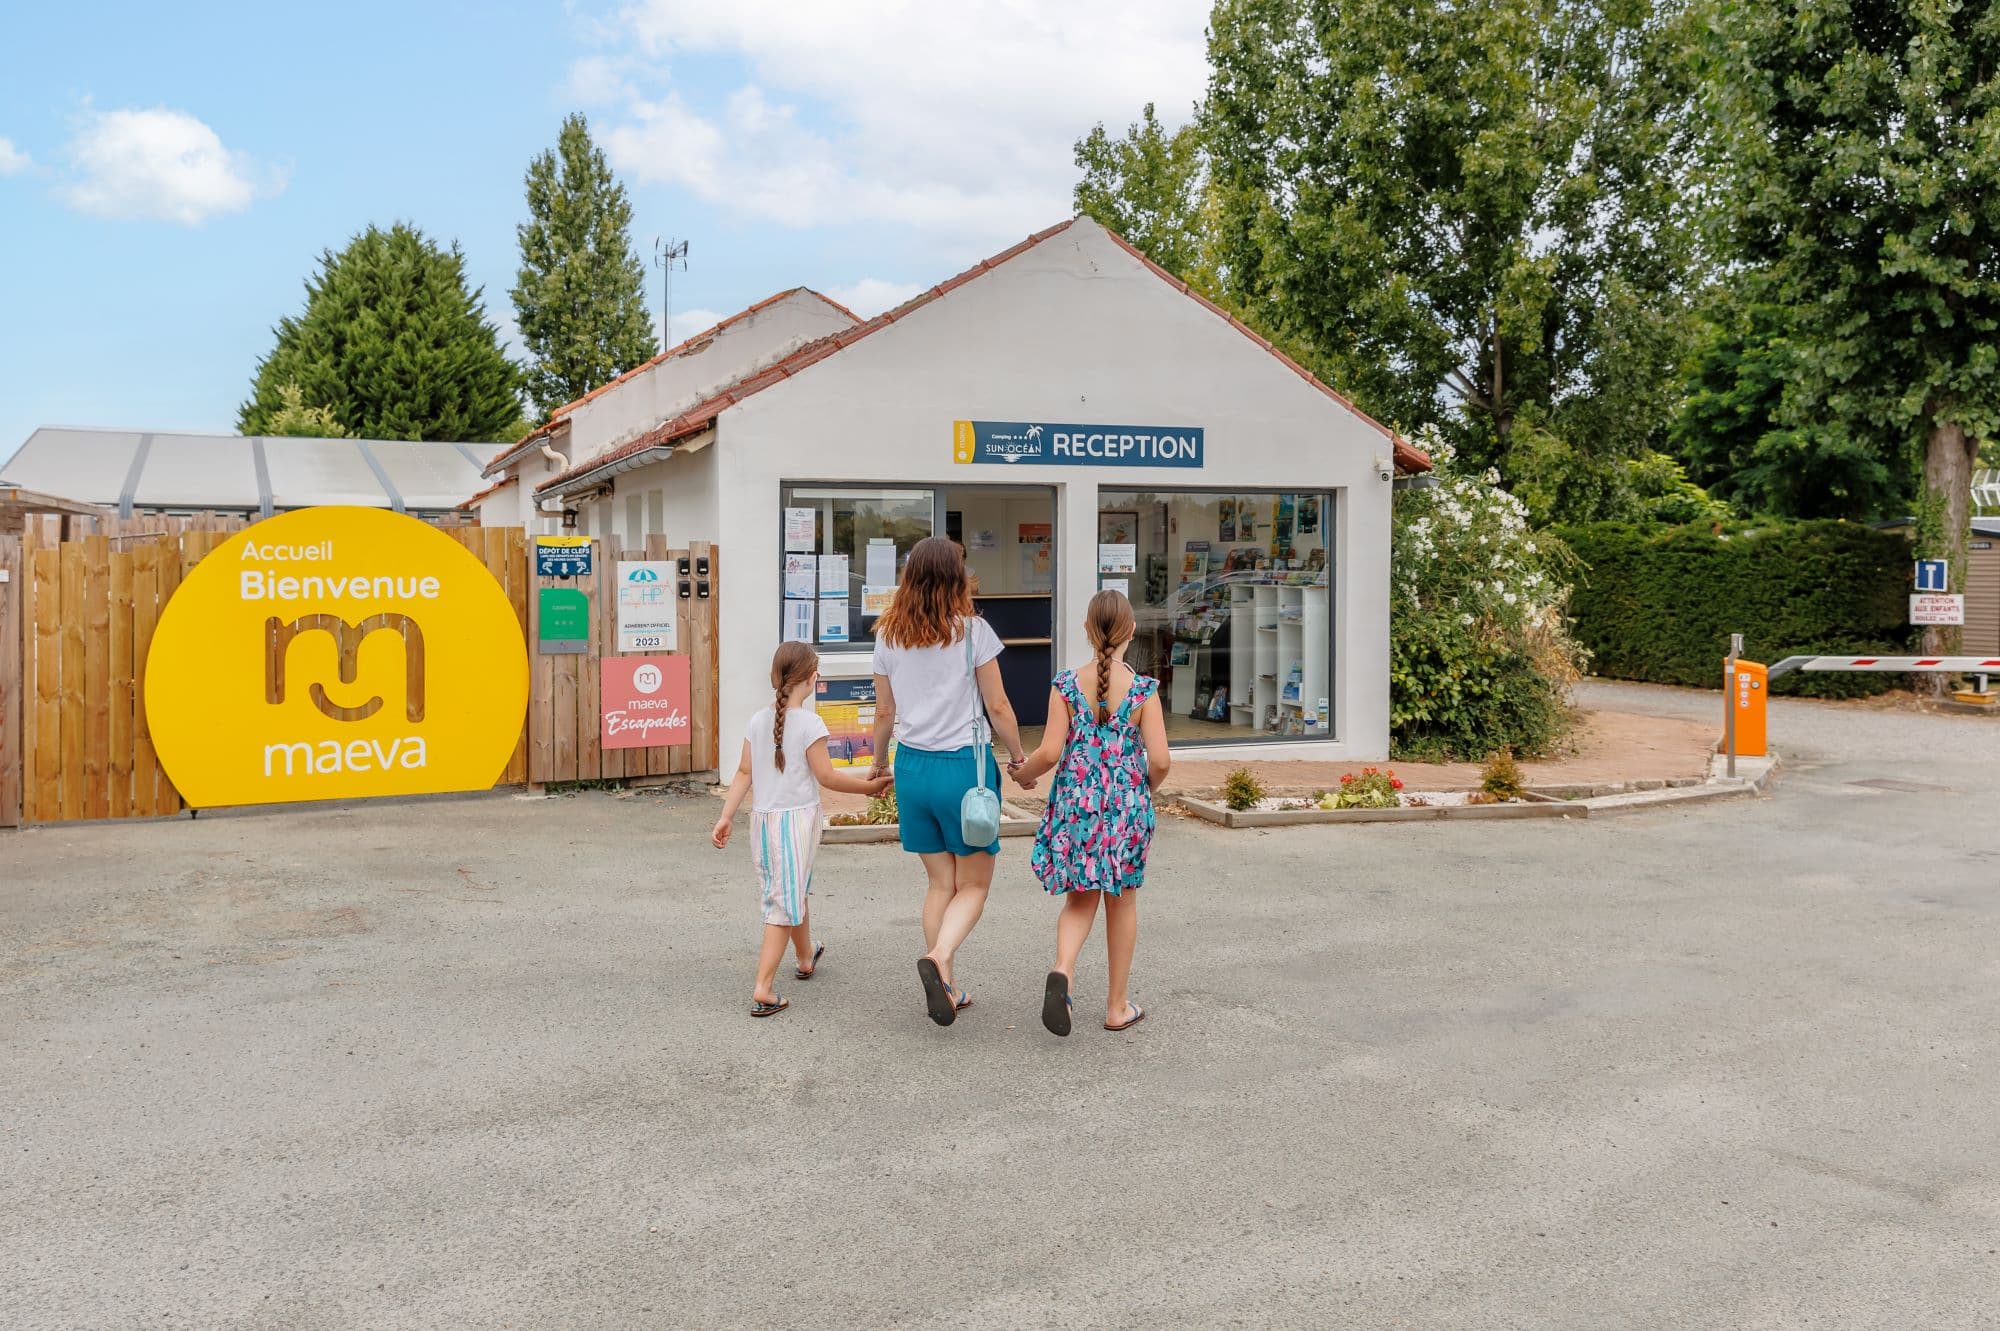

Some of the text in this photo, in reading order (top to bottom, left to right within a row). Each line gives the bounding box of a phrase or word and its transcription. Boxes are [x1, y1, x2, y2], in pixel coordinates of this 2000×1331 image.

[985, 443, 1042, 454] SUN OCÉAN
[1053, 433, 1196, 459] RECEPTION
[240, 540, 333, 561] Accueil
[240, 570, 441, 600] Bienvenue
[635, 637, 660, 647] 2023
[628, 699, 668, 710] maeva
[605, 708, 687, 739] Escapades
[264, 735, 426, 777] maeva
